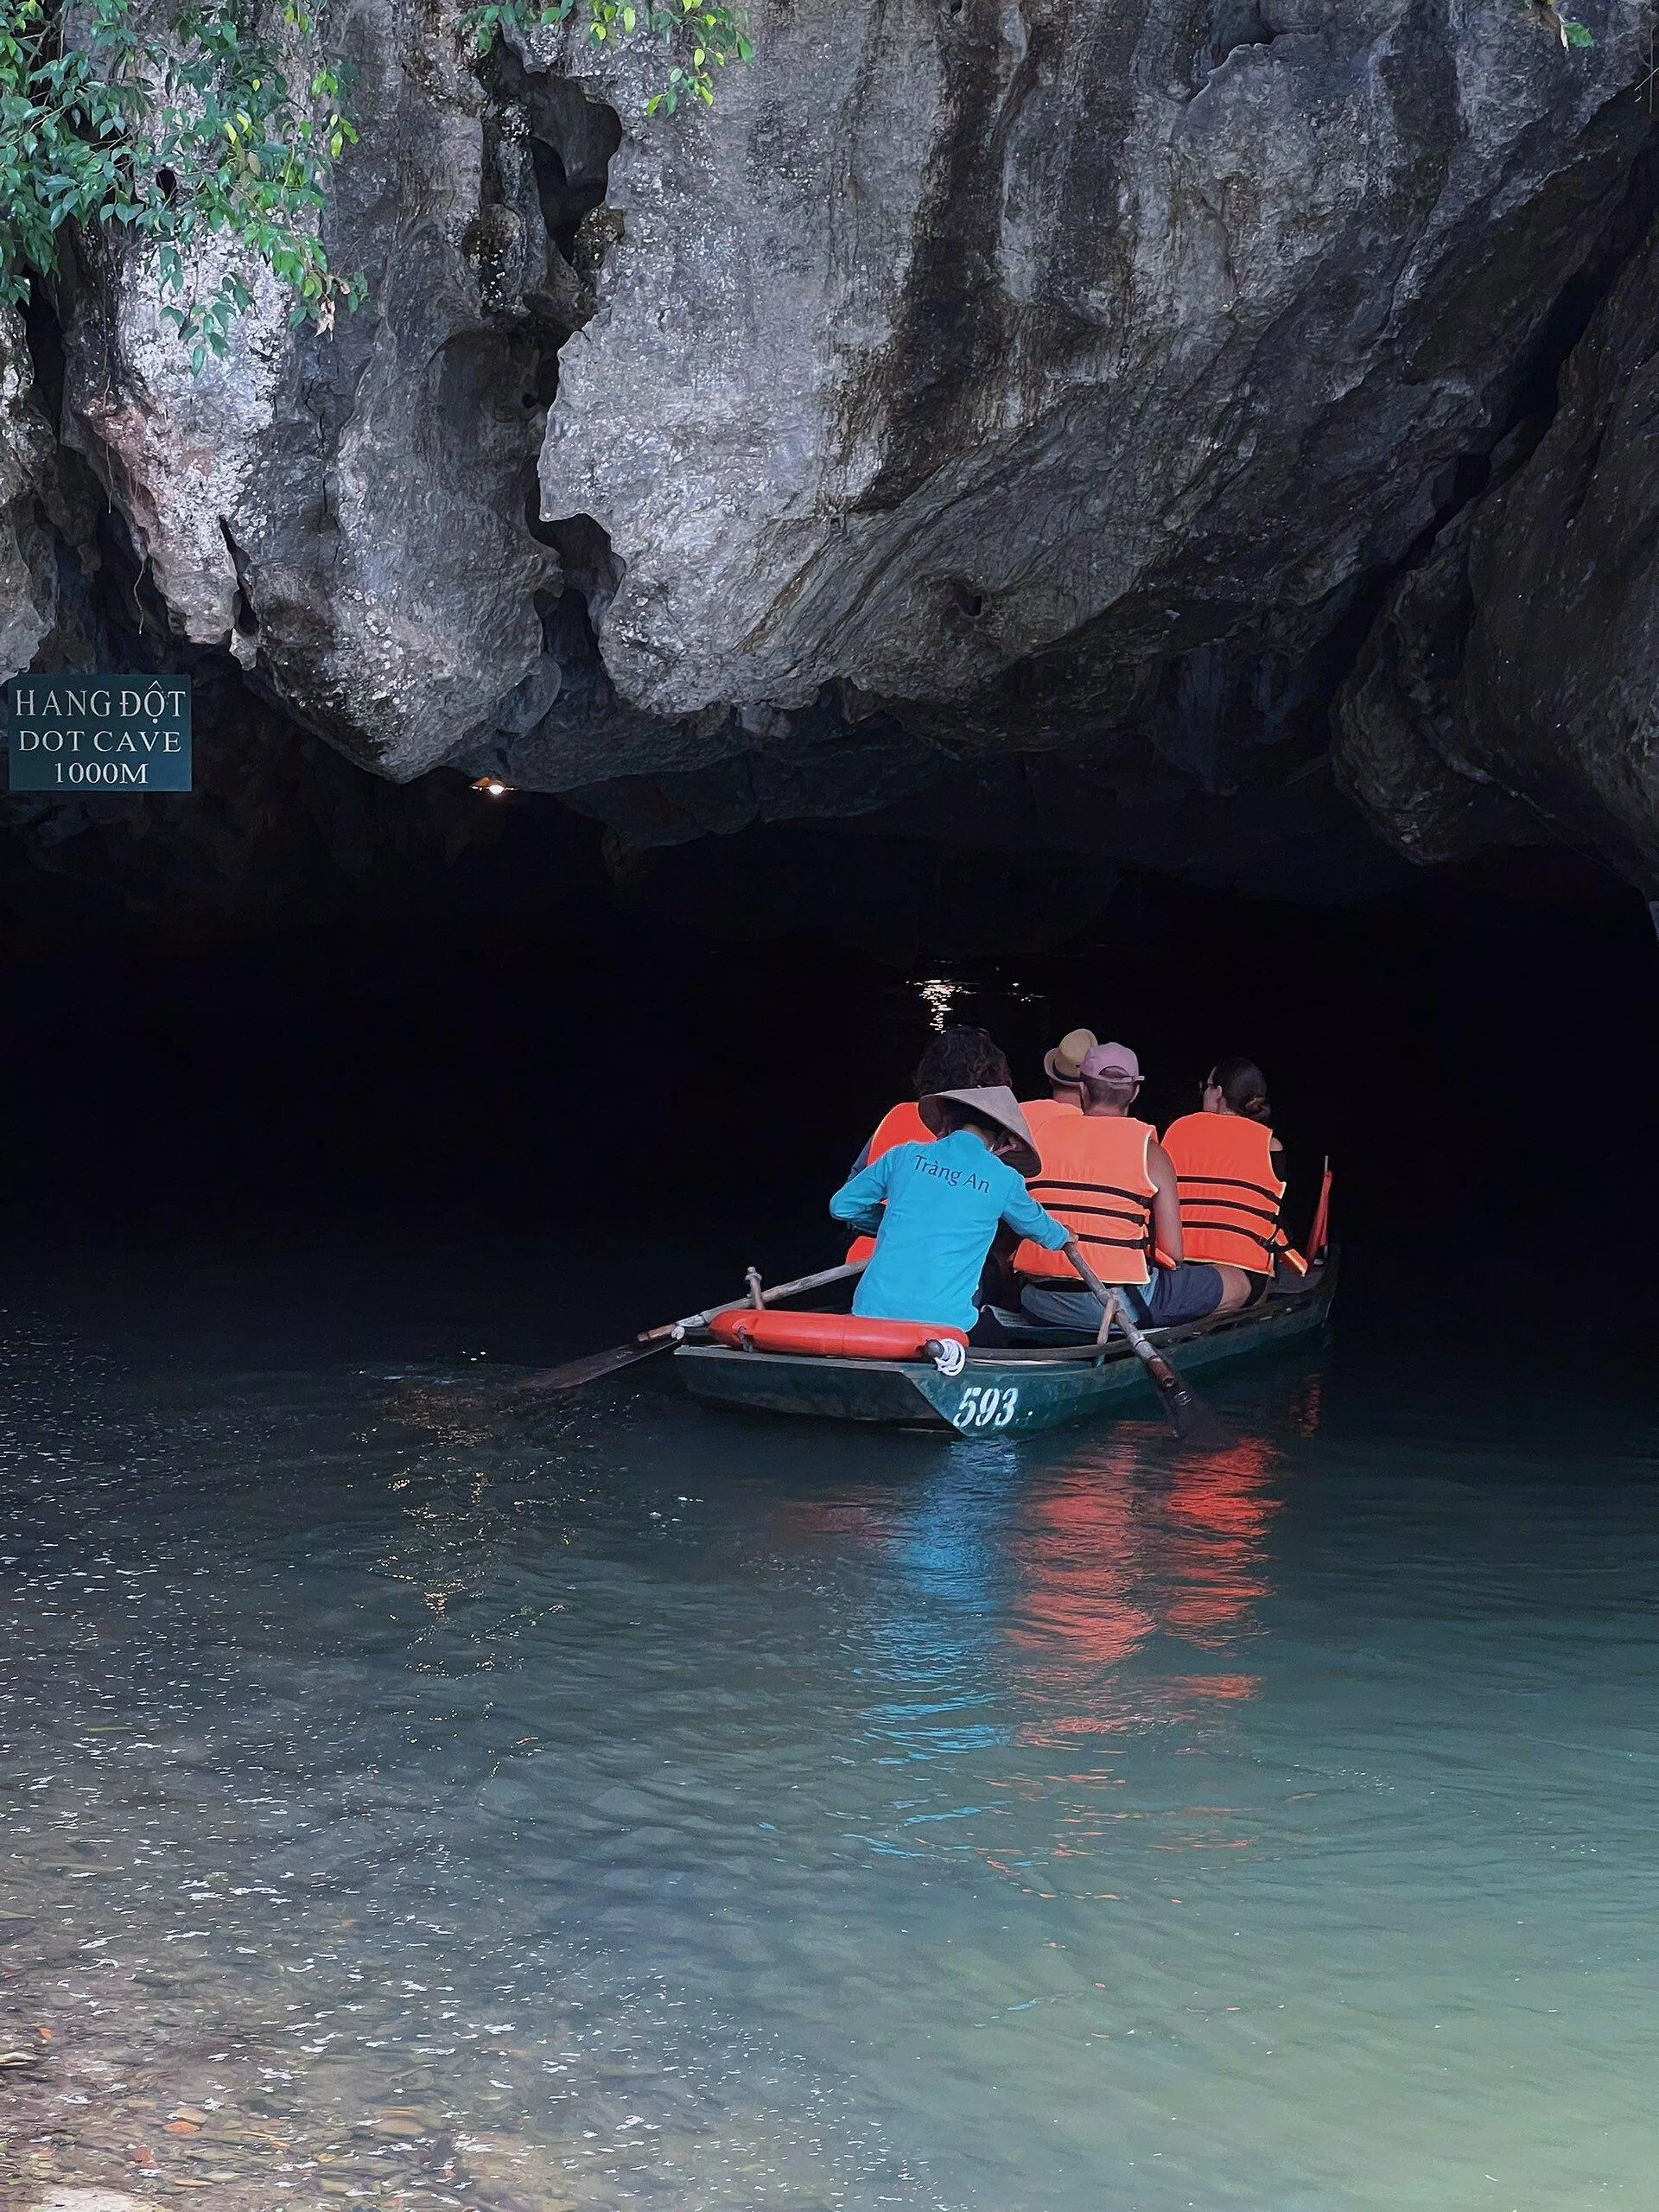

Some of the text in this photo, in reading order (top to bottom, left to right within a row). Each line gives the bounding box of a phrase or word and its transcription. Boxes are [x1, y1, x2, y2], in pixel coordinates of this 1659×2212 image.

[16, 679, 186, 724] HANG ĐỘT
[19, 730, 181, 753] DOT CAVE
[54, 762, 149, 785] 1000M
[915, 1154, 990, 1193] Tràng An
[952, 1387, 1019, 1427] 593
